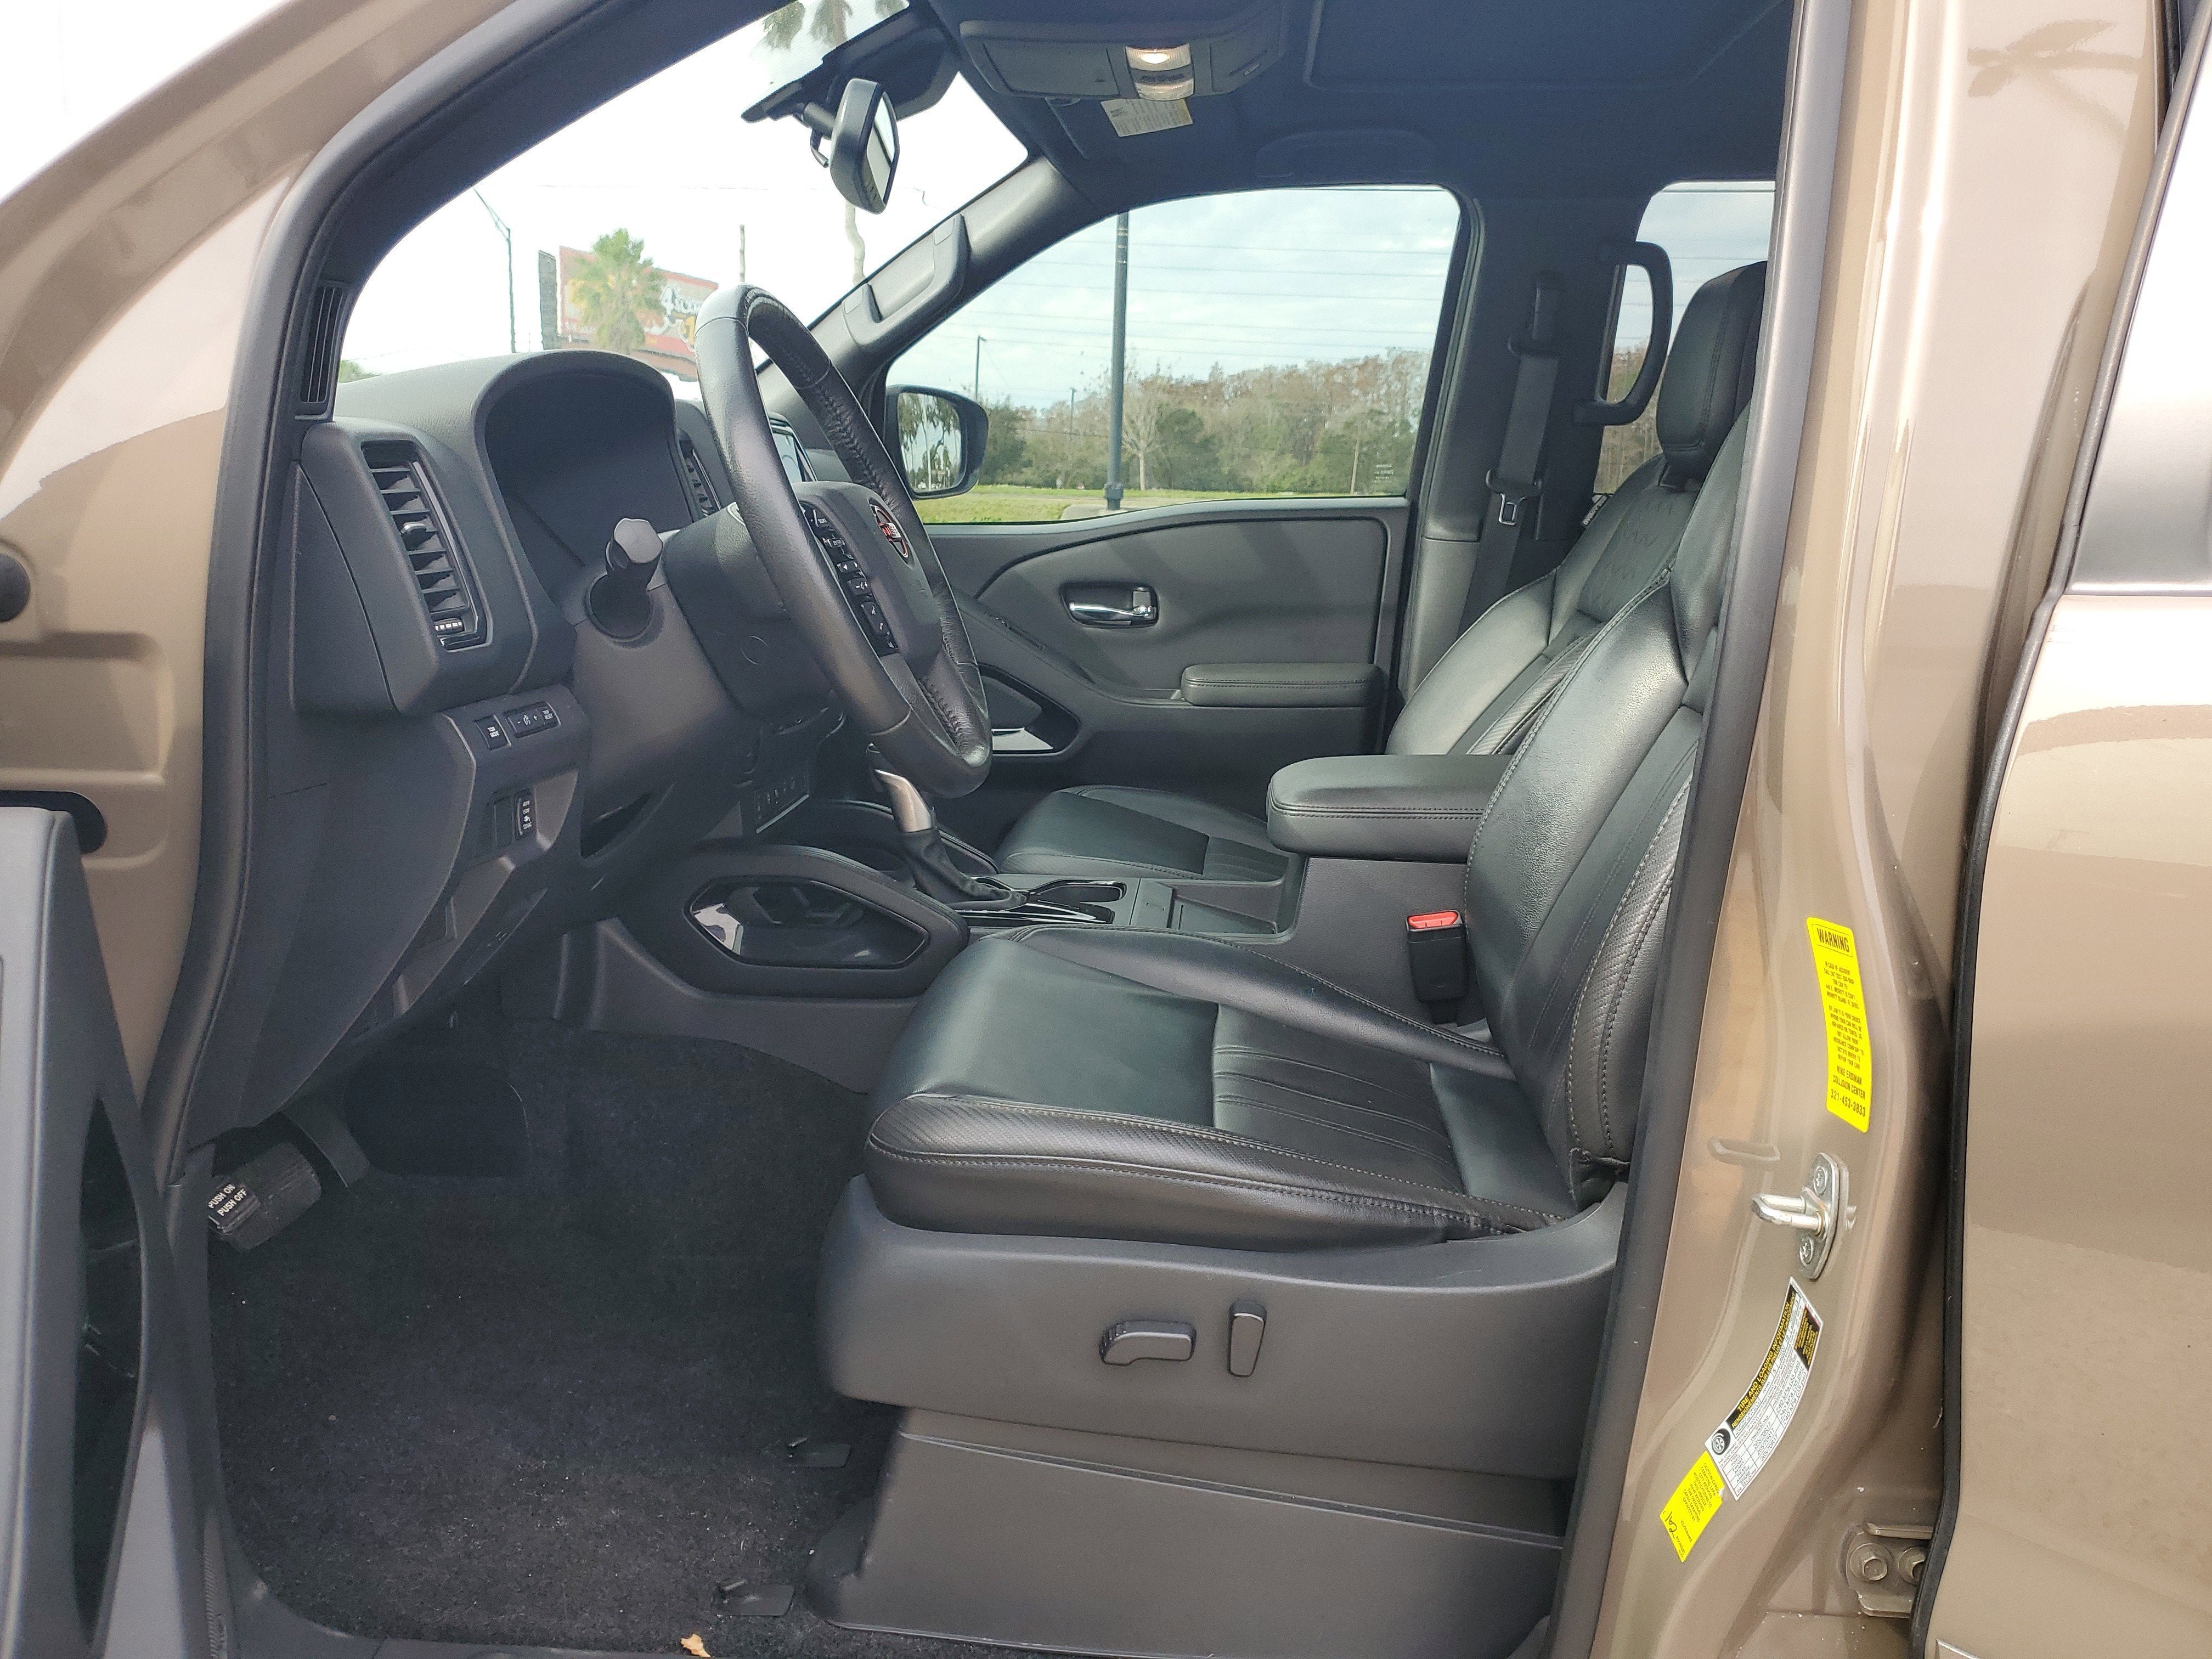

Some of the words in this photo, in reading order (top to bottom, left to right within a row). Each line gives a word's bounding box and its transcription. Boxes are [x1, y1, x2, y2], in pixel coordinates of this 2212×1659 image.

[1816, 928, 1849, 953] WARNING
[1837, 1065, 1846, 1076] MIKE
[1847, 1070, 1862, 1086] ERDMAN
[1830, 1088, 1866, 1118] 321-453-3833
[1851, 1085, 1866, 1101] CENTER
[208, 1192, 227, 1209] PUSH
[223, 1183, 236, 1194] ON
[217, 1199, 237, 1216] PUSH
[233, 1188, 247, 1201] OFF
[1737, 1395, 1749, 1412] TIRE
[1747, 1380, 1758, 1397] AND
[1757, 1350, 1774, 1382] LOADING
[1771, 1301, 1789, 1351] INFORMATION
[1770, 1344, 1780, 1363] PNEUS
[1781, 1328, 1786, 1338] LE
[1775, 1398, 1784, 1414] 240
[1779, 1404, 1787, 1419] 240
[1782, 1410, 1791, 1425] 240
[1752, 1421, 1771, 1449] 265/70R17
[1756, 1428, 1774, 1455] 265/70R17
[1759, 1433, 1778, 1462] 265/70R17
